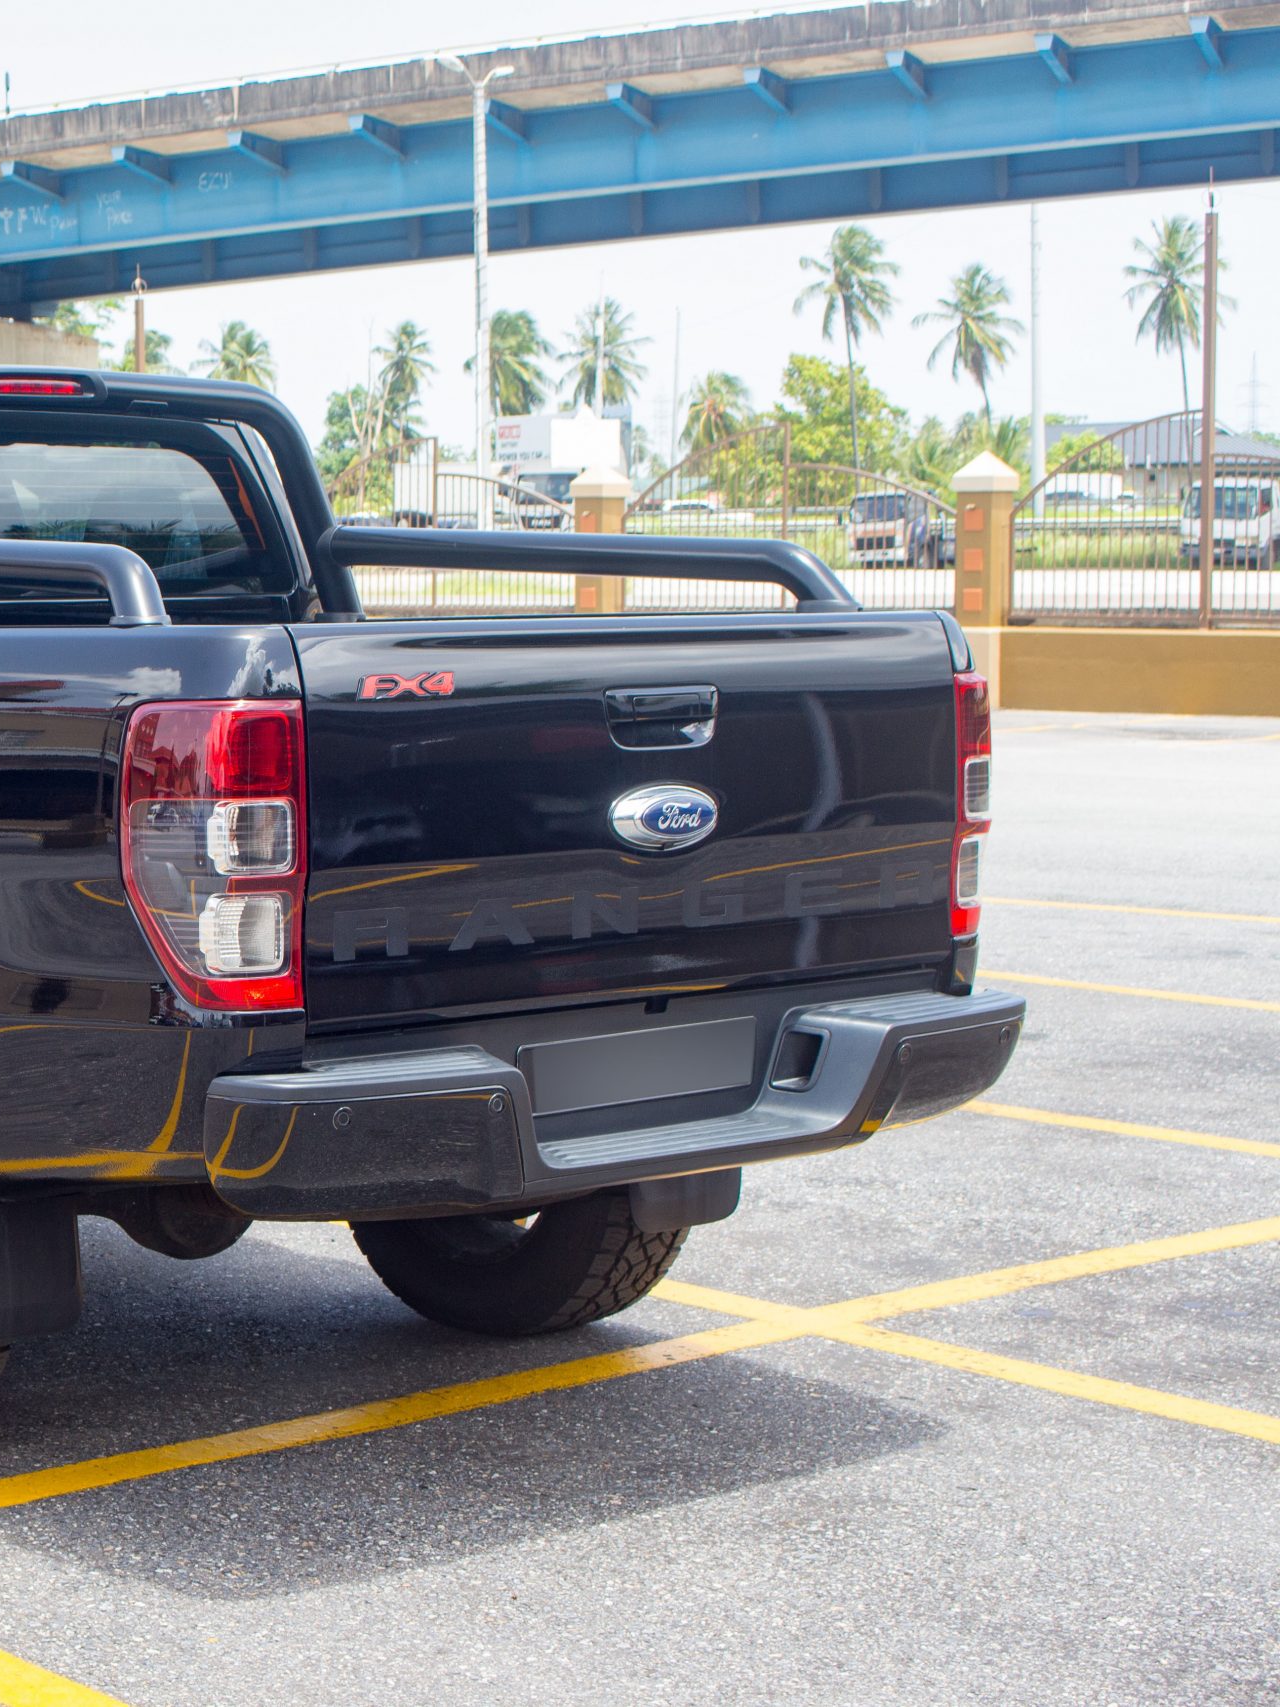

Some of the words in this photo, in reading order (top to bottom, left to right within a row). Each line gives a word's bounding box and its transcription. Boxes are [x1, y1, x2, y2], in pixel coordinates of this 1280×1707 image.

[357, 671, 455, 701] FX4
[657, 801, 702, 830] Ford
[332, 861, 936, 962] RANGER
